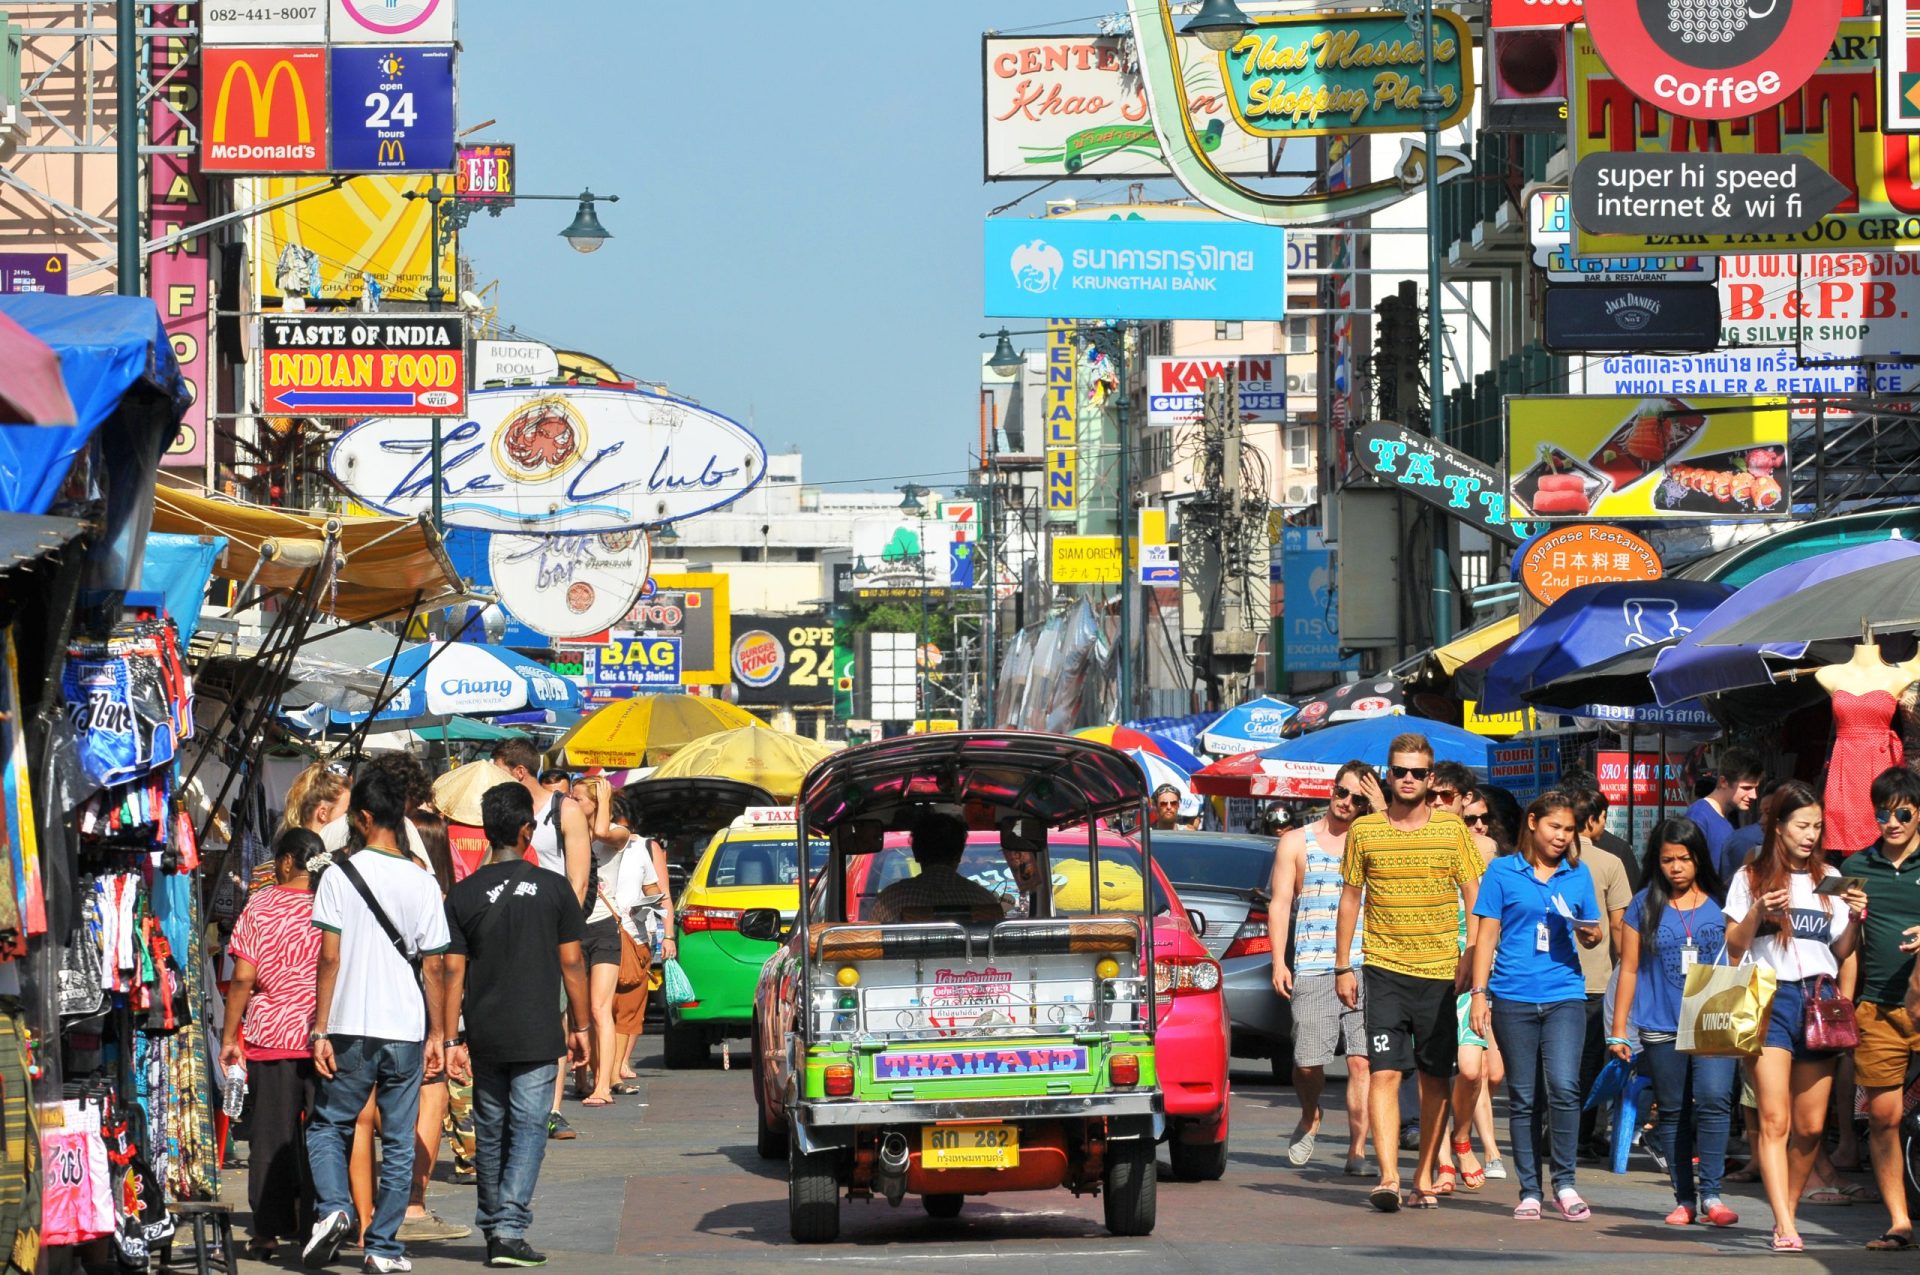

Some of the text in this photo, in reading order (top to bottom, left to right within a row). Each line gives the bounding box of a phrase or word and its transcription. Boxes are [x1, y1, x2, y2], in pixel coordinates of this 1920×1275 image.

[210, 7, 317, 21] 082-441-8007
[993, 45, 1126, 78] CENTE
[1232, 35, 1308, 75] Thai
[379, 83, 403, 91] open
[1653, 70, 1782, 108] coffee
[993, 79, 1224, 122] Khao Sn
[1246, 71, 1457, 123] Shopping Plaa
[365, 92, 418, 128] 24
[378, 130, 405, 138] hours
[211, 144, 317, 160] McDonald's
[457, 158, 511, 193] BEER
[1597, 162, 1797, 197] super hi speed
[1597, 193, 1704, 217] internet
[1711, 194, 1731, 218] &
[1746, 194, 1776, 217] wi
[1786, 193, 1802, 217] fi
[1072, 245, 1254, 277] ธนาคารกรุงไทย
[1073, 276, 1217, 291] KRUNGTHAI BANK
[1584, 274, 1601, 282] BAR
[1615, 273, 1668, 281] RESTAURANT
[1605, 293, 1662, 315] JACK DANIEL'S
[275, 325, 451, 346] TASTE OF INDIA
[1746, 326, 1813, 342] SILVER
[1819, 325, 1871, 341] SHOP
[491, 346, 542, 360] BUDGET
[269, 353, 457, 388] INDIAN FOOD
[496, 363, 536, 376] ROOM
[1615, 378, 1748, 394] WHOLESALER
[1754, 378, 1768, 392] &
[427, 396, 448, 406] Wifi
[1153, 395, 1281, 411] GUES OUSE
[380, 421, 506, 505] The
[1400, 432, 1495, 486] See the Amazing
[1050, 452, 1073, 507] INN
[1370, 438, 1550, 540] TATT
[1058, 547, 1134, 560] SIAM ORIENT
[1526, 528, 1658, 576] Japanese Restaurant
[1553, 551, 1631, 571] 日本料理
[1541, 572, 1570, 588] 2nd
[788, 627, 834, 647] OPE
[600, 641, 675, 667] BAG
[739, 641, 775, 660] BURGER
[1287, 645, 1339, 655] EXCHAN
[741, 651, 777, 674] KING
[600, 669, 675, 684] Chic & Trip Station
[440, 678, 512, 696] Chang
[1244, 721, 1283, 734] Chan
[1495, 747, 1550, 763] TOURIT
[1284, 762, 1325, 773] Chang
[1491, 763, 1556, 777] INFORMAON
[1600, 763, 1621, 780] SAO
[1600, 783, 1628, 792] MANICURE
[1373, 1034, 1390, 1053] 52
[883, 1049, 1078, 1078] THAILAND
[974, 1130, 1009, 1148] 282
[937, 1153, 1004, 1165] กรุงเทพมหานคร
